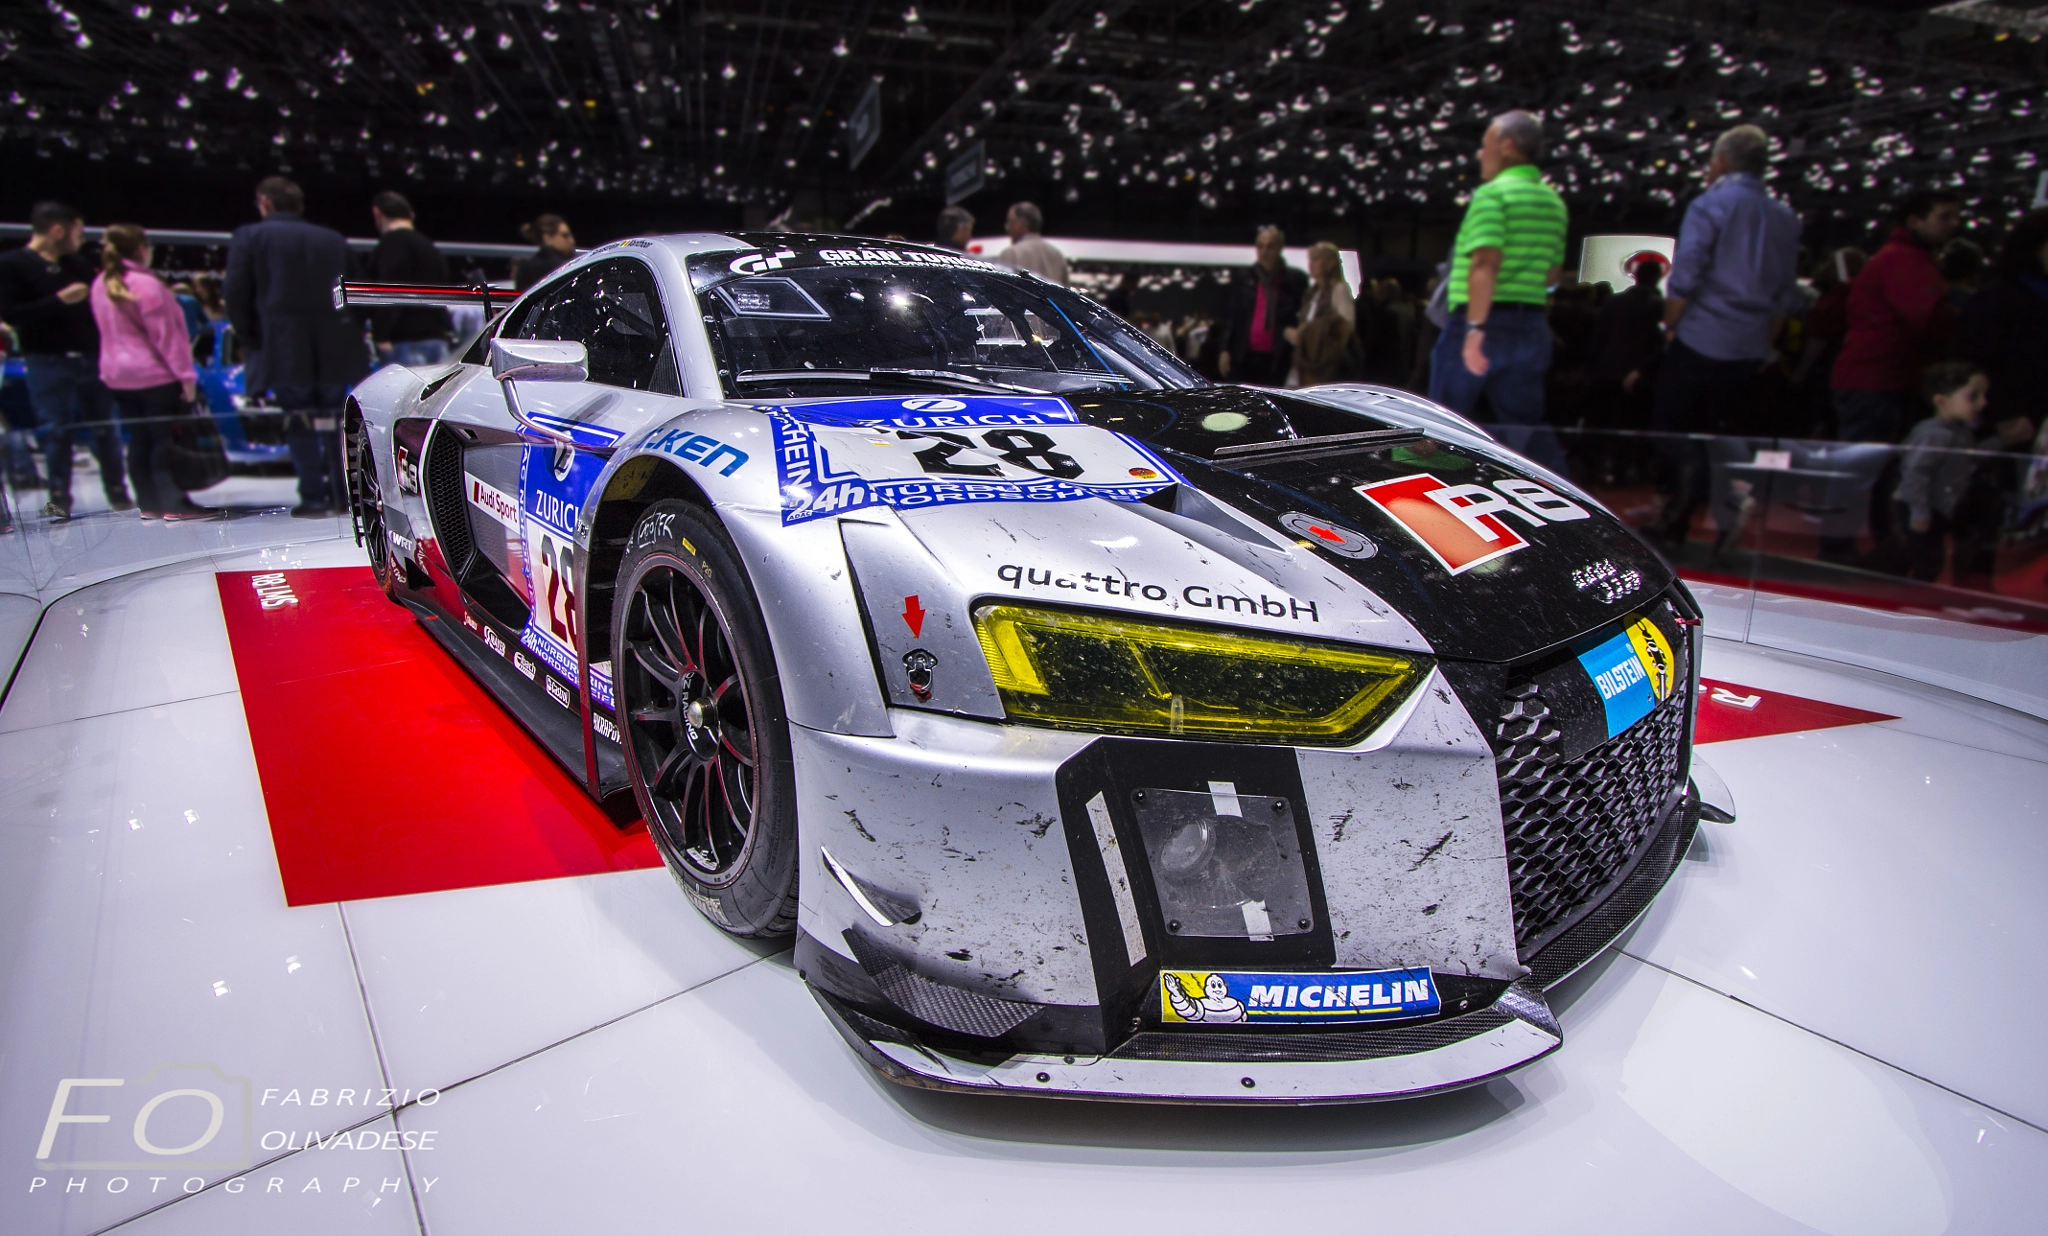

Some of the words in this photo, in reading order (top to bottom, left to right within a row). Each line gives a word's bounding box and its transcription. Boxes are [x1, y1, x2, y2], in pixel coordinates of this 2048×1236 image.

[819, 249, 902, 261] GRAN
[871, 427, 1085, 480] 28
[867, 483, 1163, 500] NÜRBURRIN
[480, 485, 495, 511] Audi
[495, 493, 518, 523] Sport
[789, 511, 812, 520] ADAC
[1423, 479, 1591, 543] R8
[393, 531, 412, 551] WRT
[251, 573, 286, 589] R8
[256, 585, 299, 609] LMS
[997, 564, 1167, 602] quattro
[1183, 585, 1320, 623] GmbH
[683, 672, 695, 689] OZ
[1595, 655, 1646, 700] BILSTEIN
[1248, 979, 1430, 1008] MICHELIN
